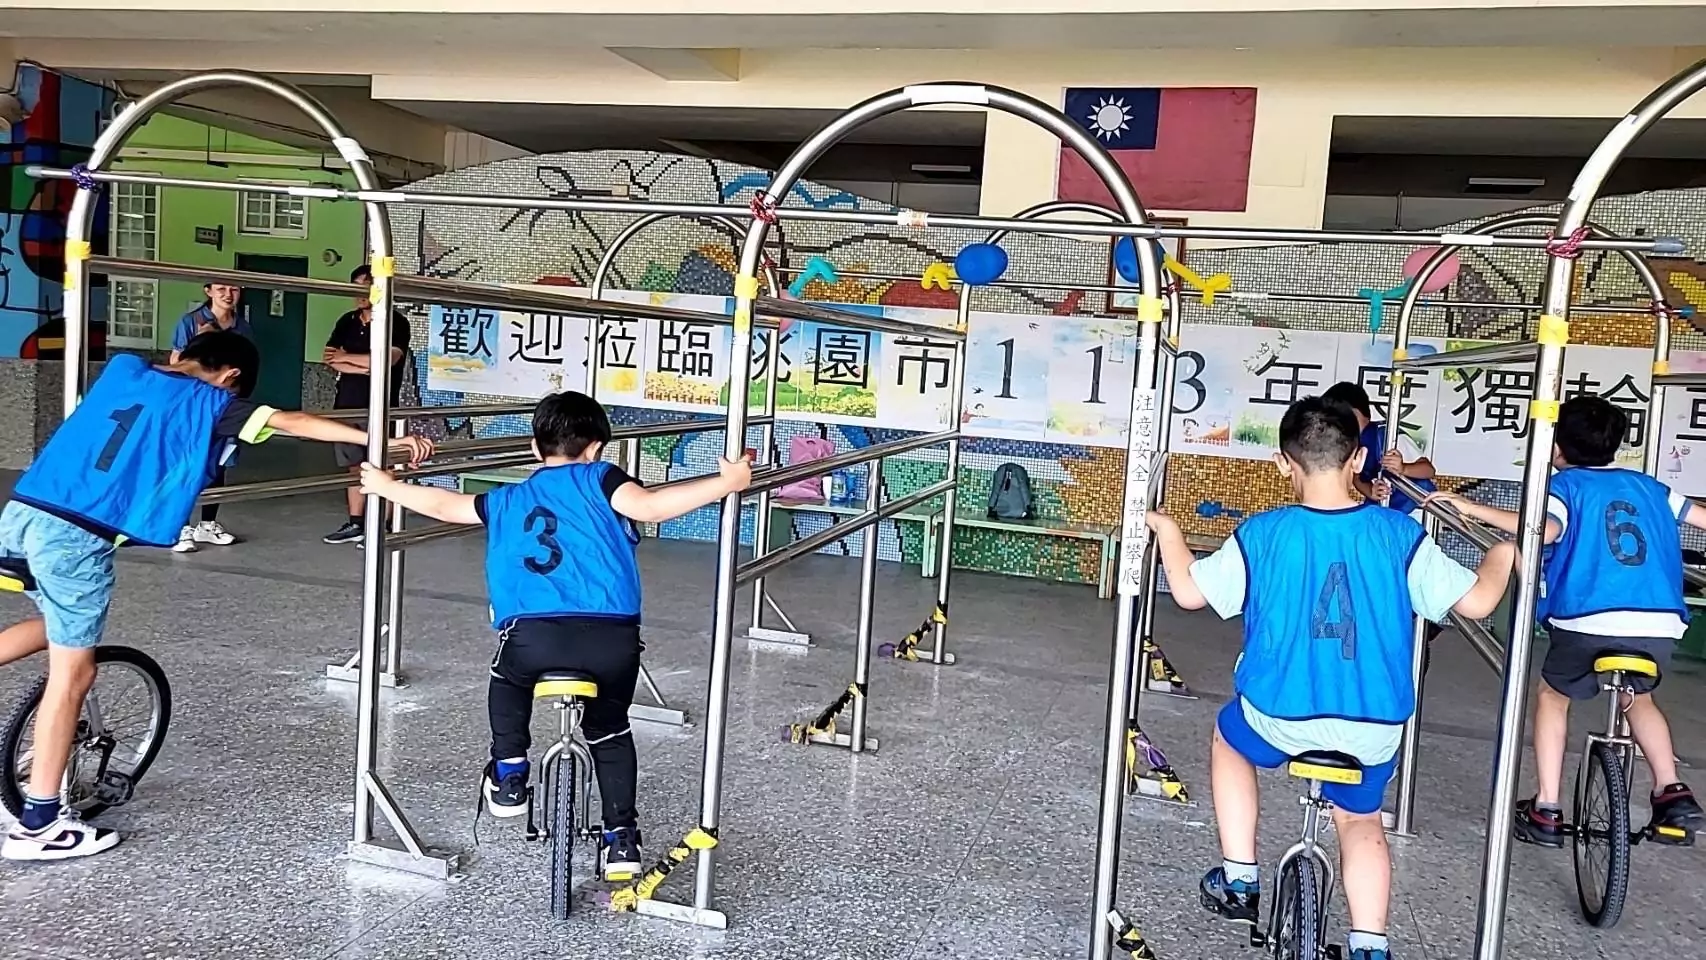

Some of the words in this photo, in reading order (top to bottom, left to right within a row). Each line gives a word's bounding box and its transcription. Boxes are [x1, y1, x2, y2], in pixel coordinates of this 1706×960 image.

[94, 403, 145, 472] 1
[1132, 394, 1154, 482] 注意安全
[523, 505, 563, 575] 3
[1123, 496, 1145, 585] 禁止攀爬
[1605, 500, 1647, 566] 6
[1311, 561, 1356, 660] 4
